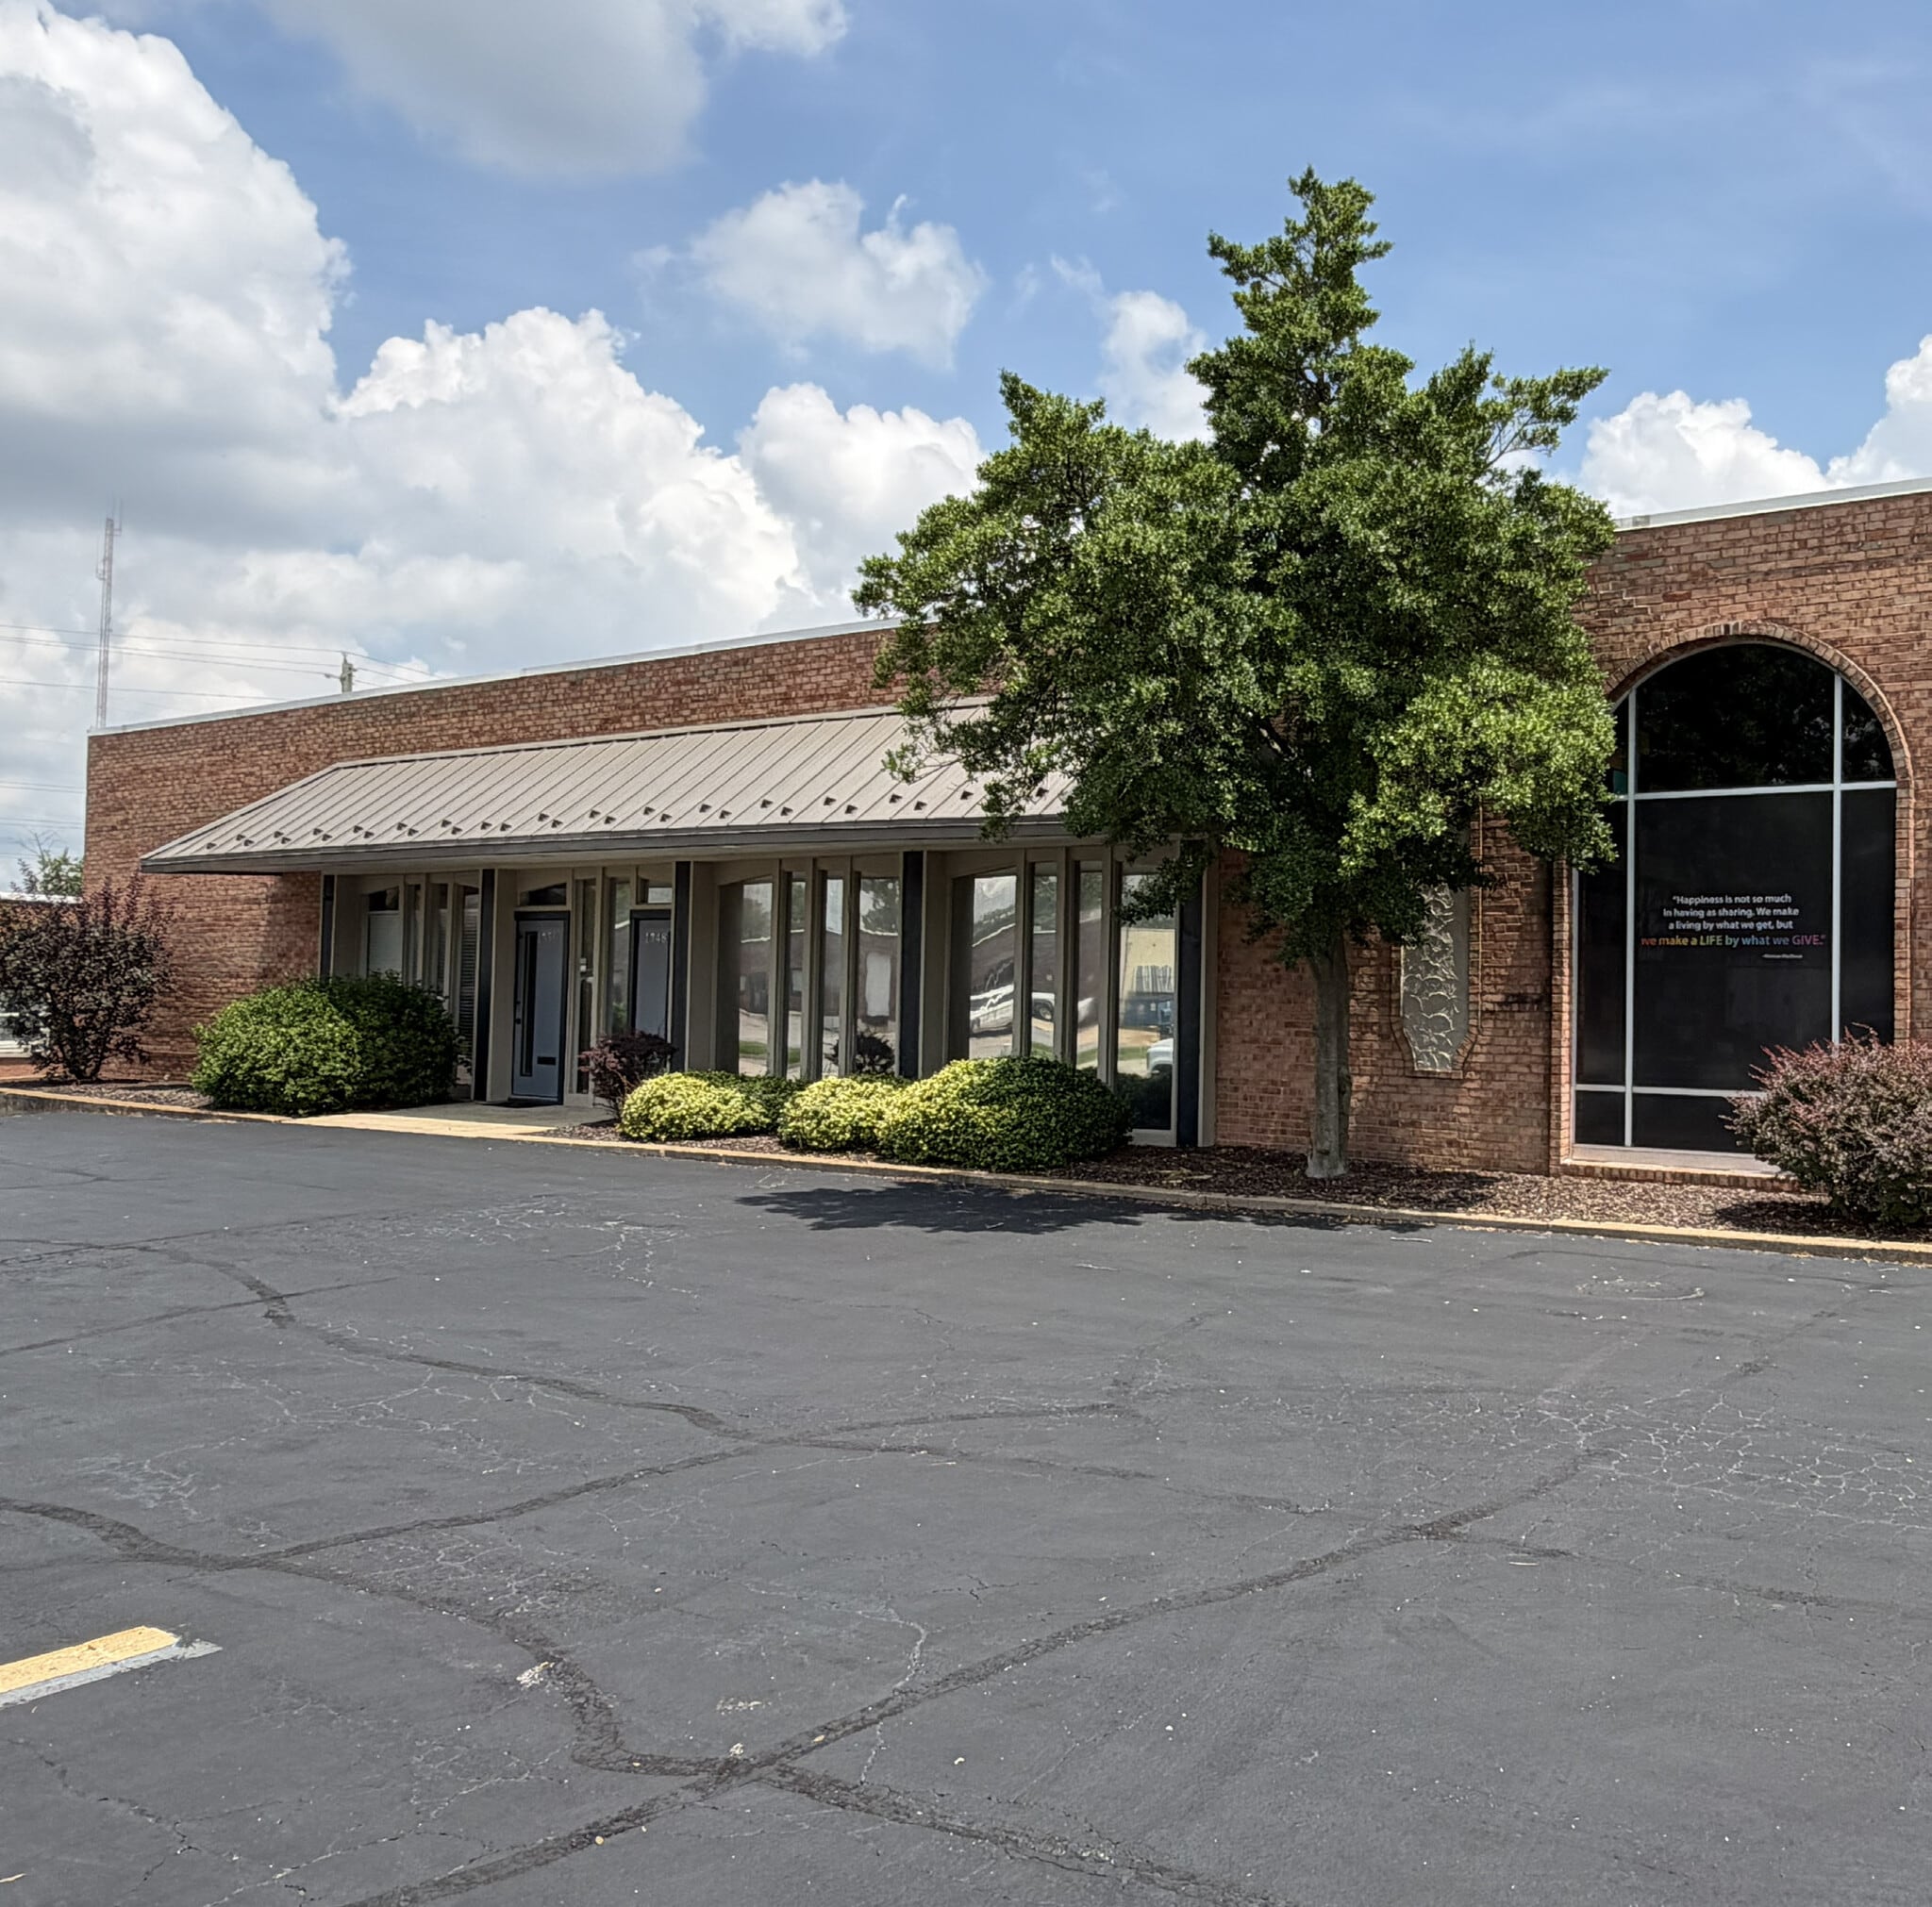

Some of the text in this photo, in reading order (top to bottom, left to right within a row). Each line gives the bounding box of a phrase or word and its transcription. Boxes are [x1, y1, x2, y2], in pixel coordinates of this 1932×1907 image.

[1725, 894, 1733, 904] is
[1765, 893, 1791, 904] much
[1663, 908, 1672, 917] in
[1674, 908, 1705, 919] having
[1718, 907, 1755, 919] sharing.
[1756, 907, 1772, 916] We
[1773, 906, 1799, 916] make
[1675, 920, 1701, 932] living
[1703, 920, 1714, 931] by
[1716, 920, 1740, 930] what
[1776, 920, 1793, 929] but
[1658, 936, 1689, 945] make
[1700, 935, 1723, 946] LIFE
[1725, 936, 1740, 948] by
[1741, 935, 1770, 945] what
